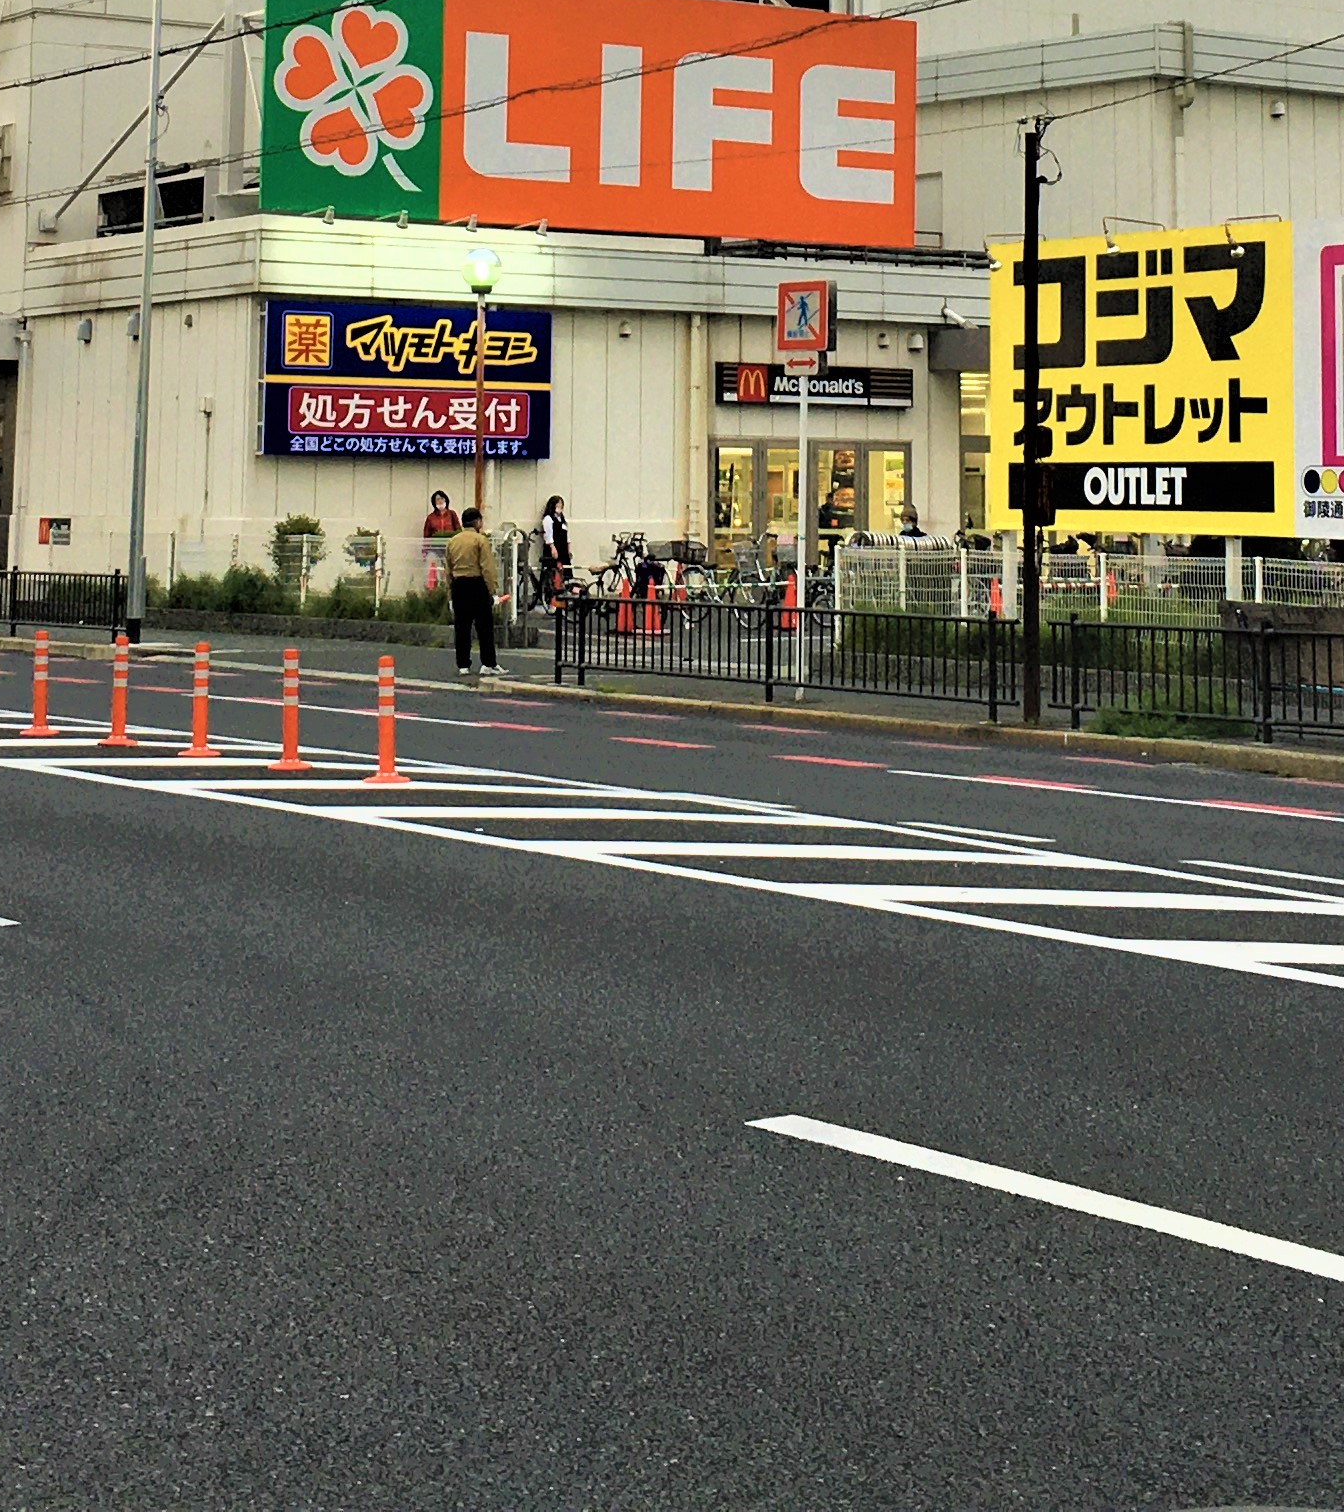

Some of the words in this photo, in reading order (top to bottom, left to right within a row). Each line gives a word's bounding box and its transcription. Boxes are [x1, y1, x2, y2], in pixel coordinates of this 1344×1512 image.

[462, 31, 897, 206] LIFE
[1012, 240, 1266, 370] コジマ
[288, 318, 328, 364] 薬
[345, 315, 538, 375] マツモトキヨシ
[298, 391, 522, 433] 処方せん受付
[1013, 377, 1268, 448] アウトレット
[1083, 465, 1188, 506] OUTLET
